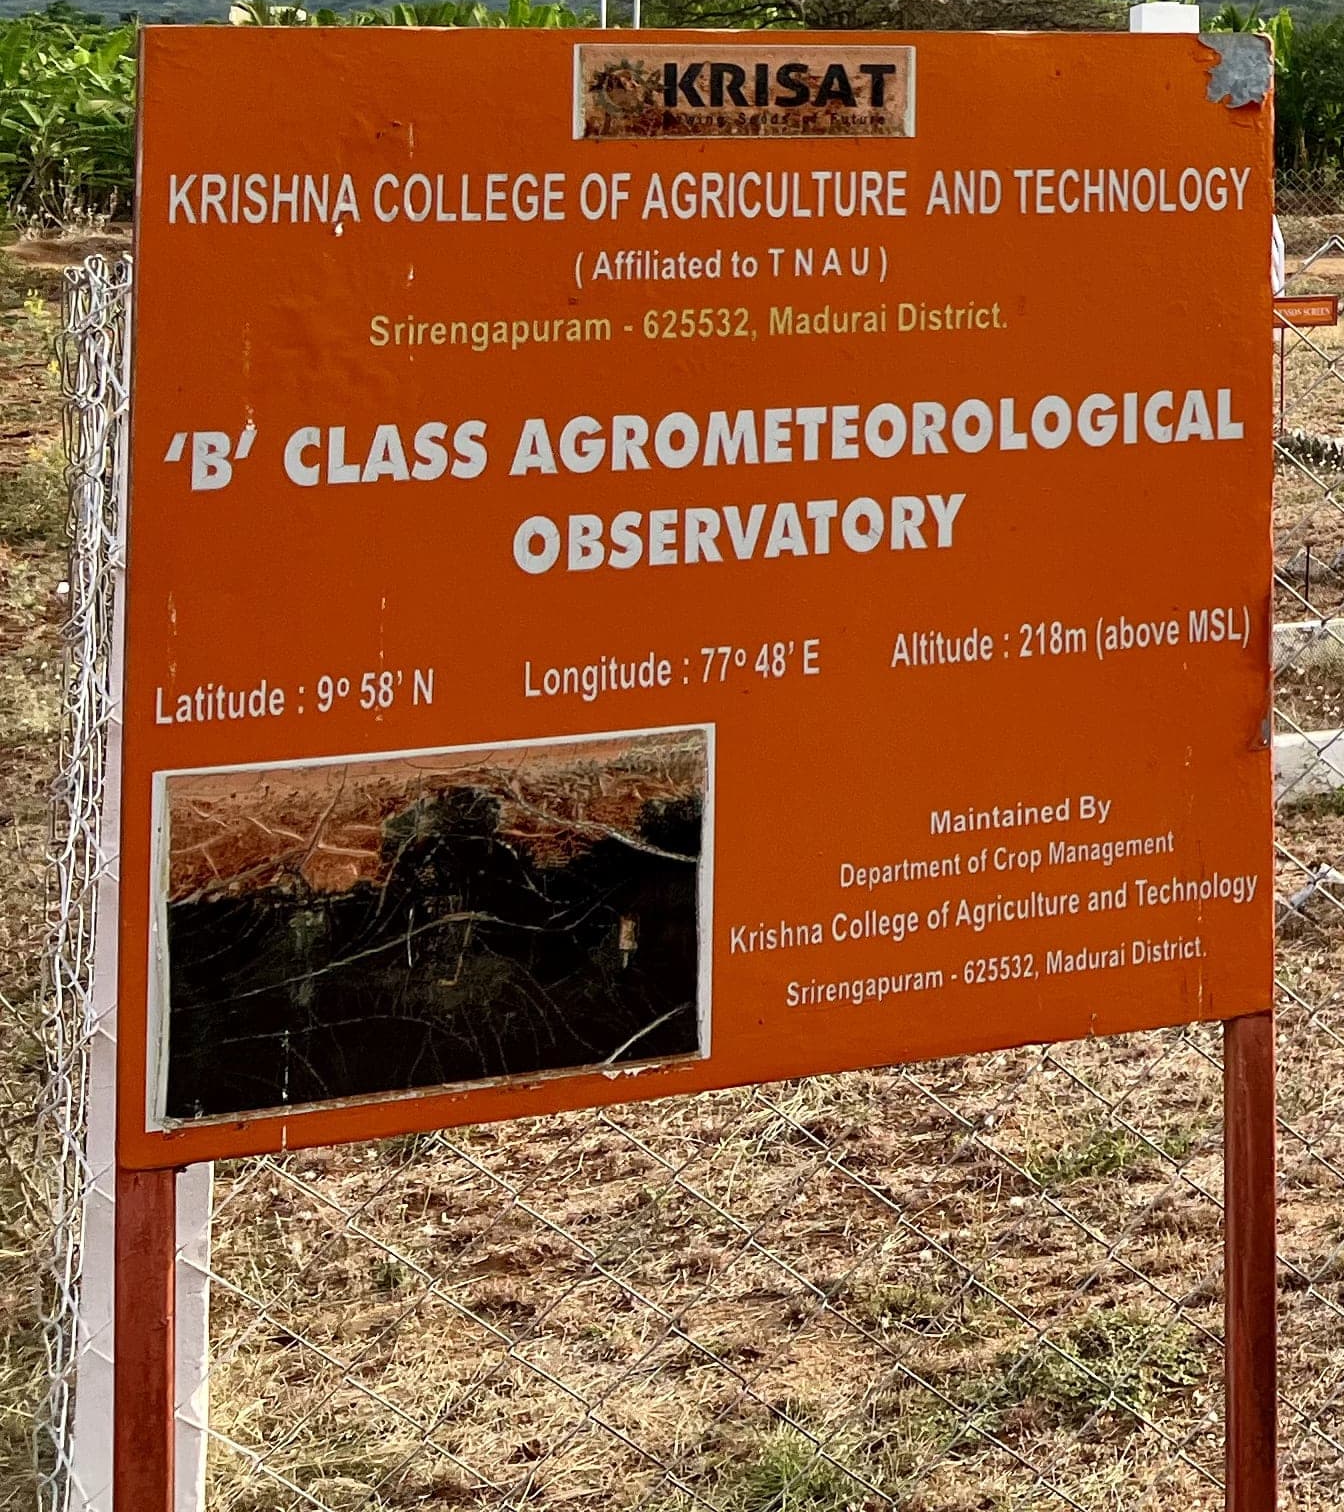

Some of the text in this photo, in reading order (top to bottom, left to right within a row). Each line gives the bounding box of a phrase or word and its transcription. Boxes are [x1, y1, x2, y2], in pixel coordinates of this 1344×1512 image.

[663, 62, 896, 107] KRISAT
[167, 166, 1251, 224] KRISHNA COLLEGE OF AGRICULTURE AND TECHNOLOGY
[591, 249, 722, 281] Affiliated
[731, 250, 758, 278] to
[767, 248, 785, 277] T
[794, 247, 813, 277] N
[821, 247, 842, 276] A
[851, 247, 869, 276] U
[369, 315, 611, 352] Srirengapuram
[643, 307, 757, 342] 625532,
[769, 303, 886, 336] Madurai
[898, 301, 1007, 331] District.
[283, 420, 488, 487] CLASS
[508, 388, 1244, 476] AGROMETEOROLOGICAL
[513, 493, 967, 575] OBSERVATORY
[891, 627, 993, 668] Altitude
[1019, 621, 1087, 657] 218m
[1096, 615, 1180, 660] (above
[1189, 607, 1250, 649] MSL)
[155, 679, 285, 725] Latitude
[413, 668, 434, 705] N
[525, 651, 672, 702] Longitude
[803, 638, 820, 675] E
[930, 795, 1111, 835] Maintained By
[840, 831, 1174, 890] Department of Crop Management
[730, 872, 1258, 954] Krishna College of Agriculture and Technology
[786, 970, 943, 1007] Srirengapuram
[964, 953, 1039, 984] 625532,
[1046, 947, 1125, 975] Madurai
[1132, 936, 1208, 965] District.
